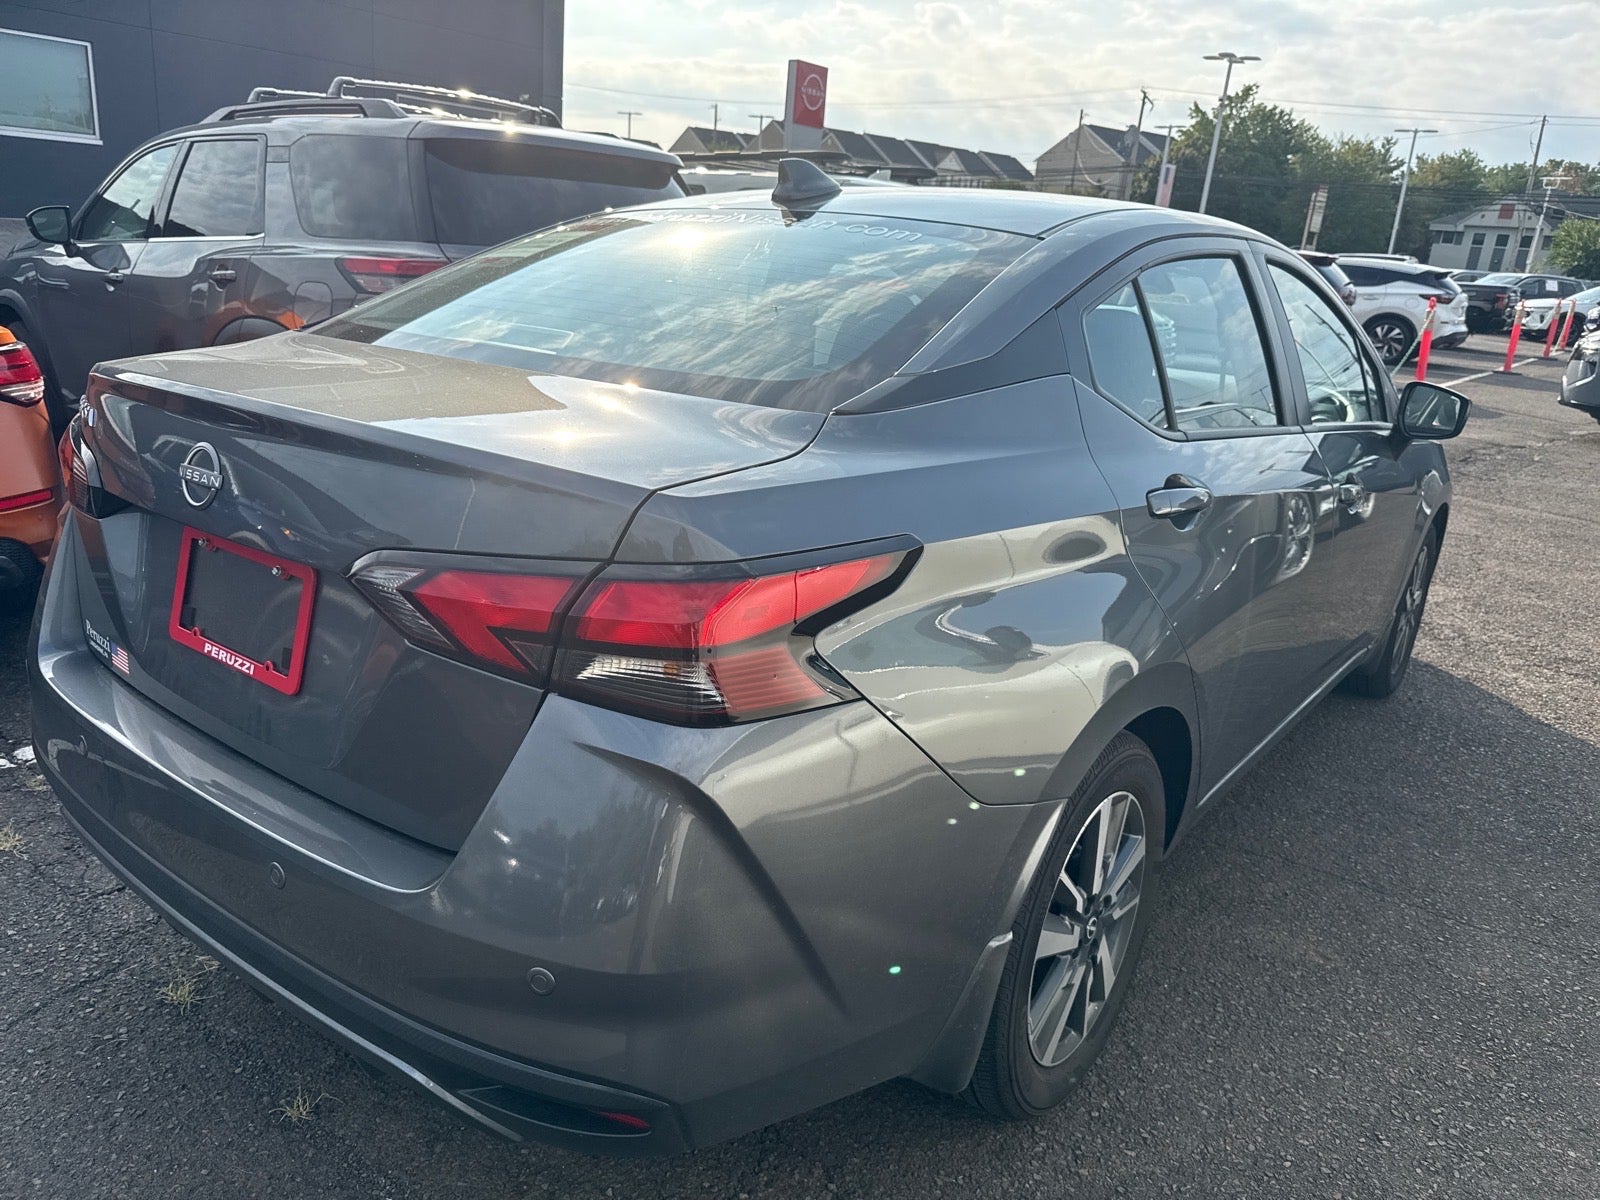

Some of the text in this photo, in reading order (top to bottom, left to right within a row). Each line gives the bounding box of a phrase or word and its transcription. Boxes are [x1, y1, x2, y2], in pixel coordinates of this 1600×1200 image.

[180, 466, 220, 488] NISSAN
[85, 618, 111, 653] Peruzzi
[203, 642, 255, 675] PERUZZI
